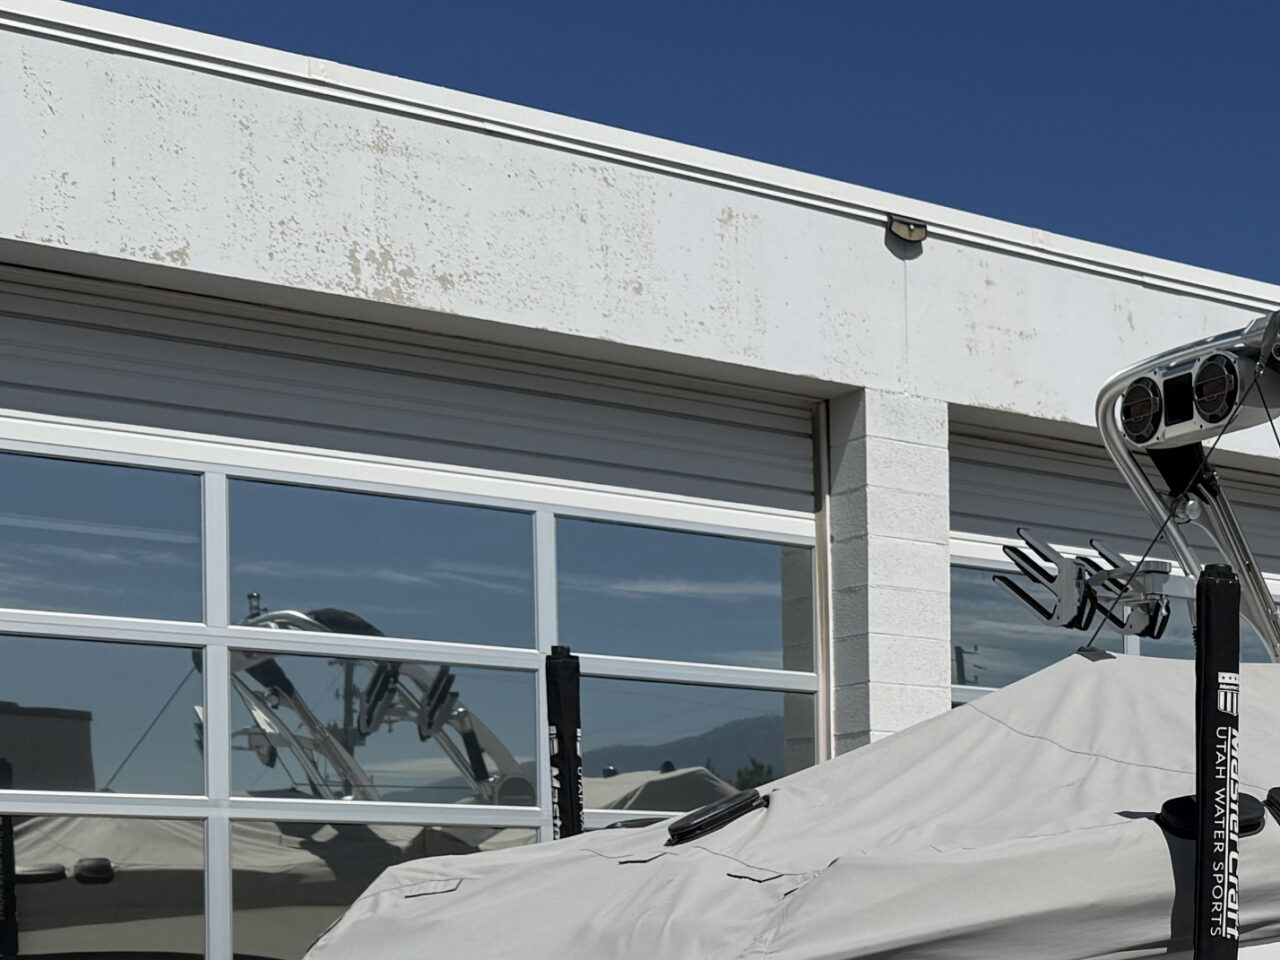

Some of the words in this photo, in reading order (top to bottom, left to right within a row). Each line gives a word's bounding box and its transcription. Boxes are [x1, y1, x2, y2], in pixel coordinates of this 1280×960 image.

[1215, 726, 1228, 779] UTAH
[1213, 787, 1226, 853] WATER
[1210, 861, 1225, 937] SPORTS
